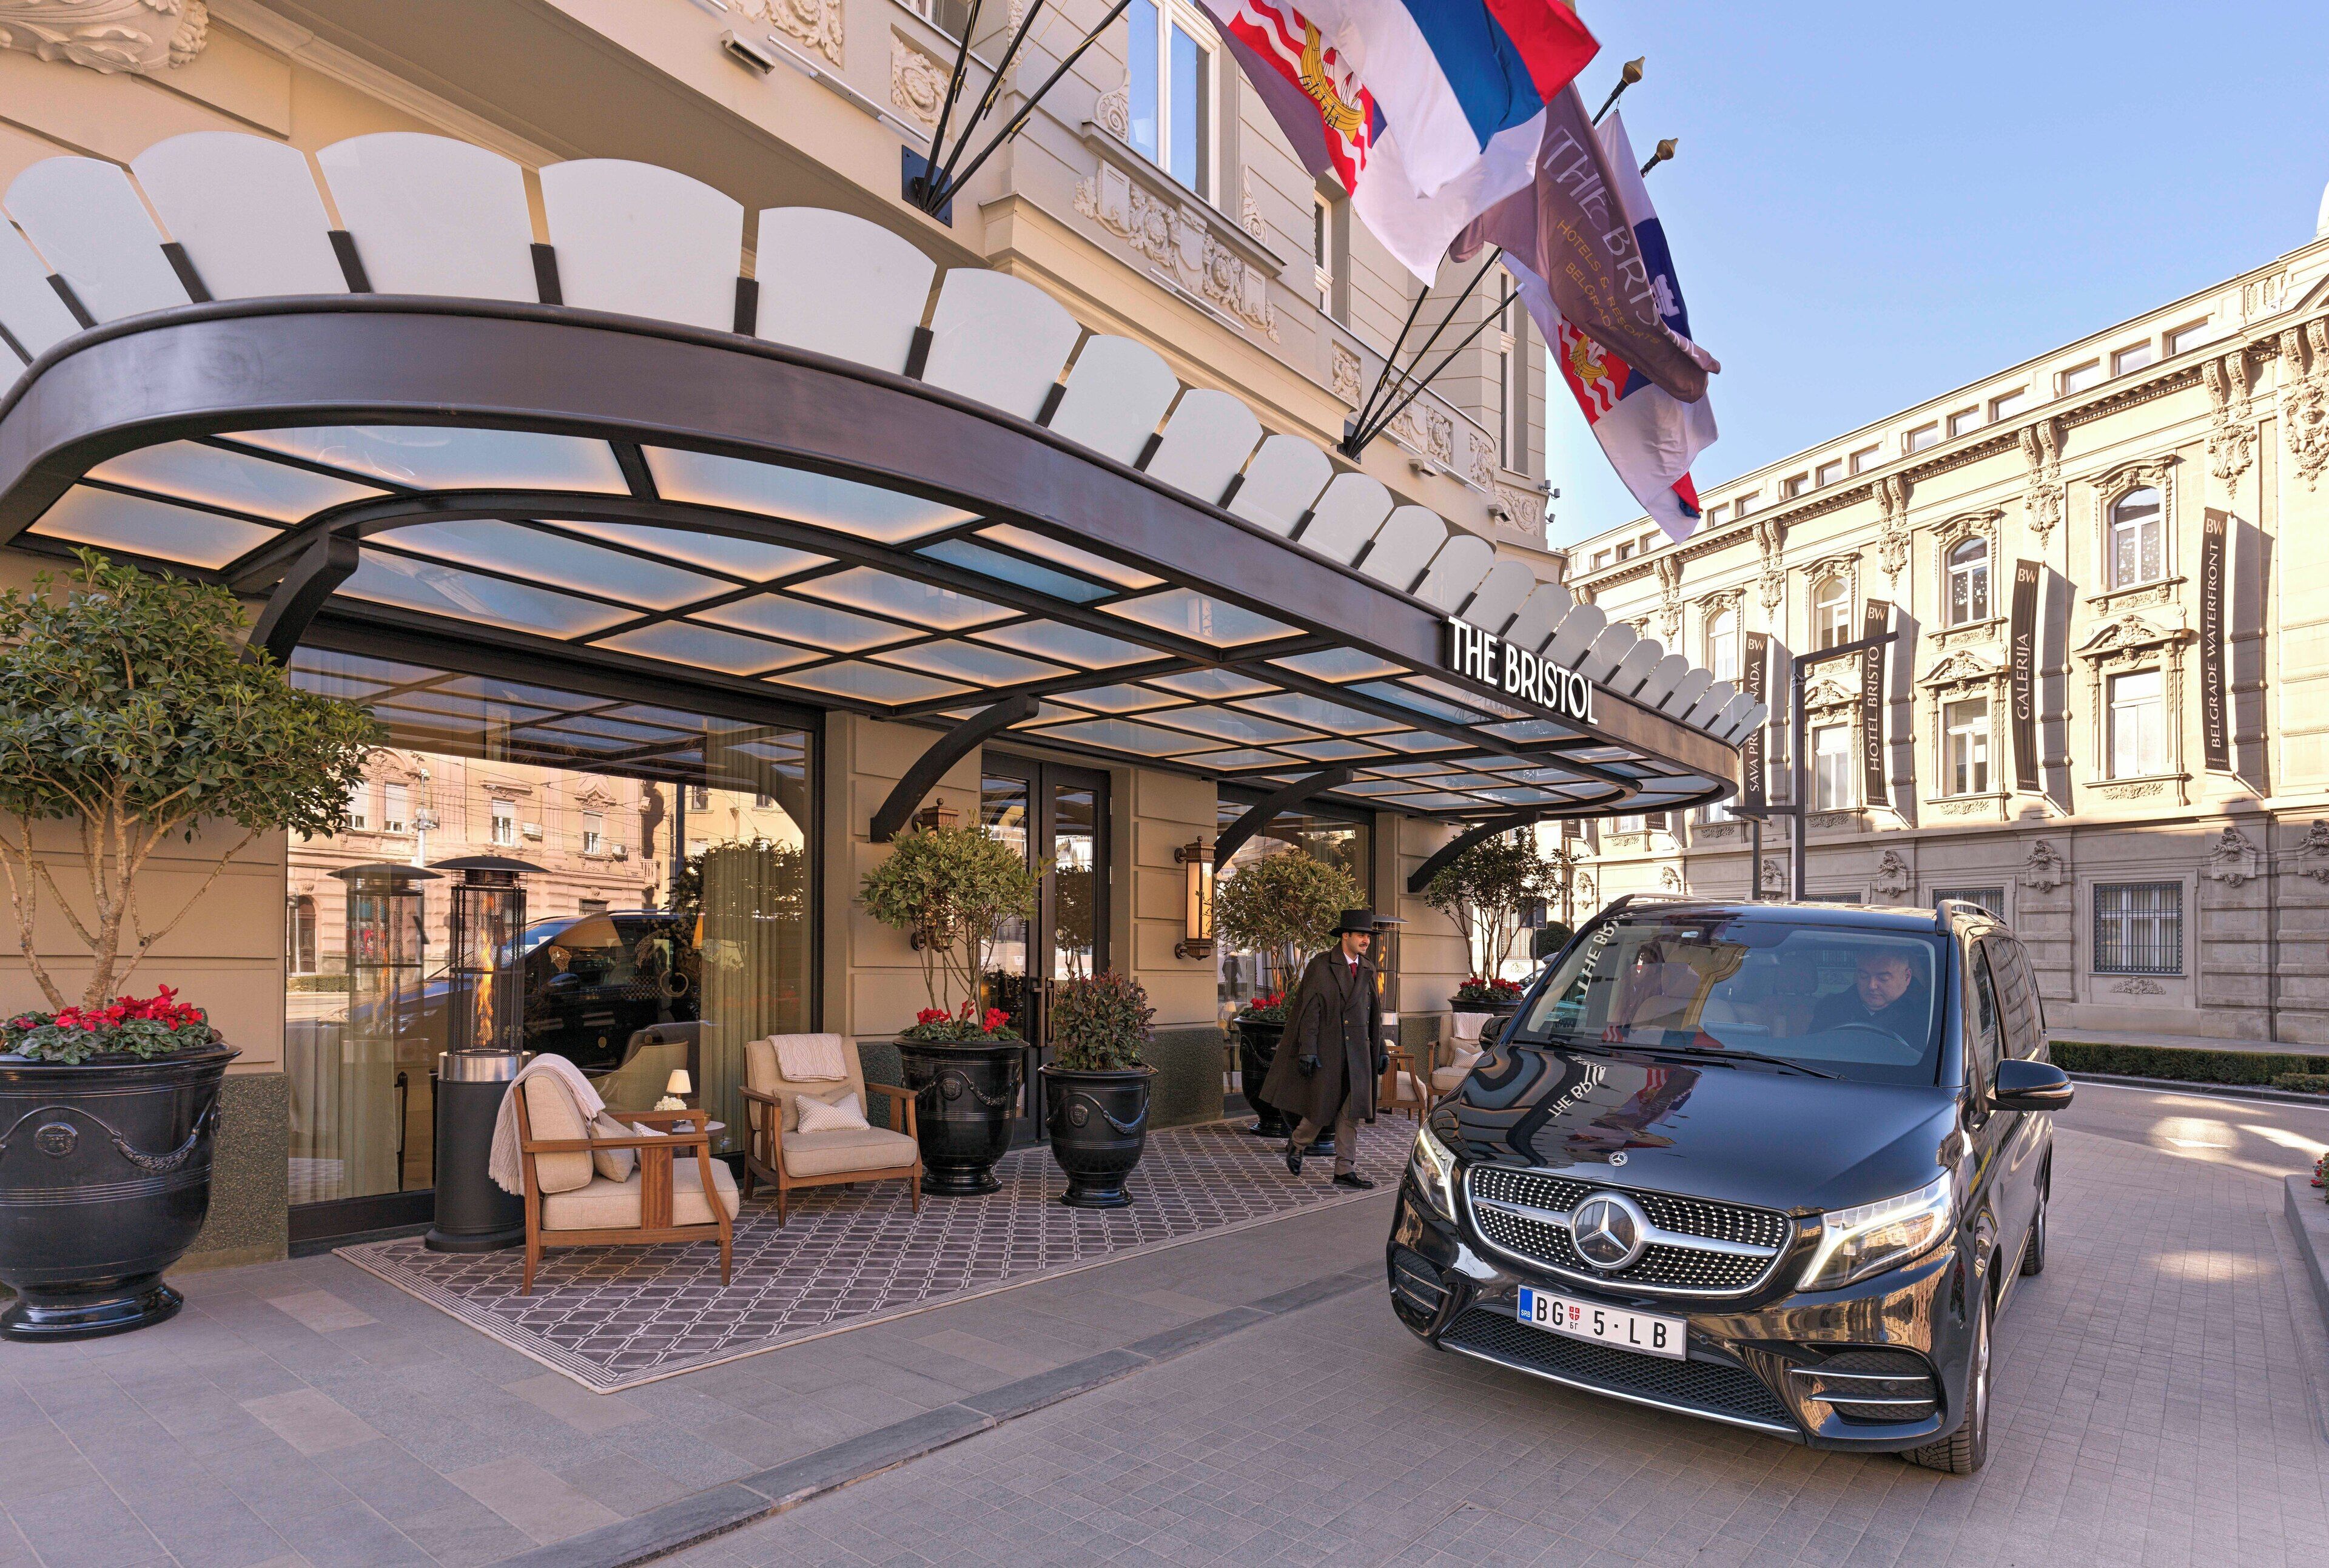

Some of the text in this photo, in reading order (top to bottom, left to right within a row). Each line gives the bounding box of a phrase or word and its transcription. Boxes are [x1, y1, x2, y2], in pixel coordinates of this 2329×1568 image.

[1543, 127, 1613, 219] THE
[1557, 220, 1661, 344] HOTELS & RESORTS
[1565, 262, 1619, 332] BELGRADE
[2206, 517, 2225, 536] BW
[2017, 568, 2037, 584] BW
[1868, 607, 1886, 621] BW
[1748, 638, 1766, 651] BW
[2206, 540, 2221, 748] BELGRADE WATERFRONT
[1448, 615, 1598, 725] THE BRISTOL
[2016, 633, 2031, 720] GALERIJA
[1867, 646, 1880, 771] HOTEL BRISTO
[1749, 758, 1760, 792] SAVA
[1521, 1309, 1531, 1318] SRB
[1536, 1296, 1564, 1326] BG
[1569, 1321, 1579, 1330] БГ
